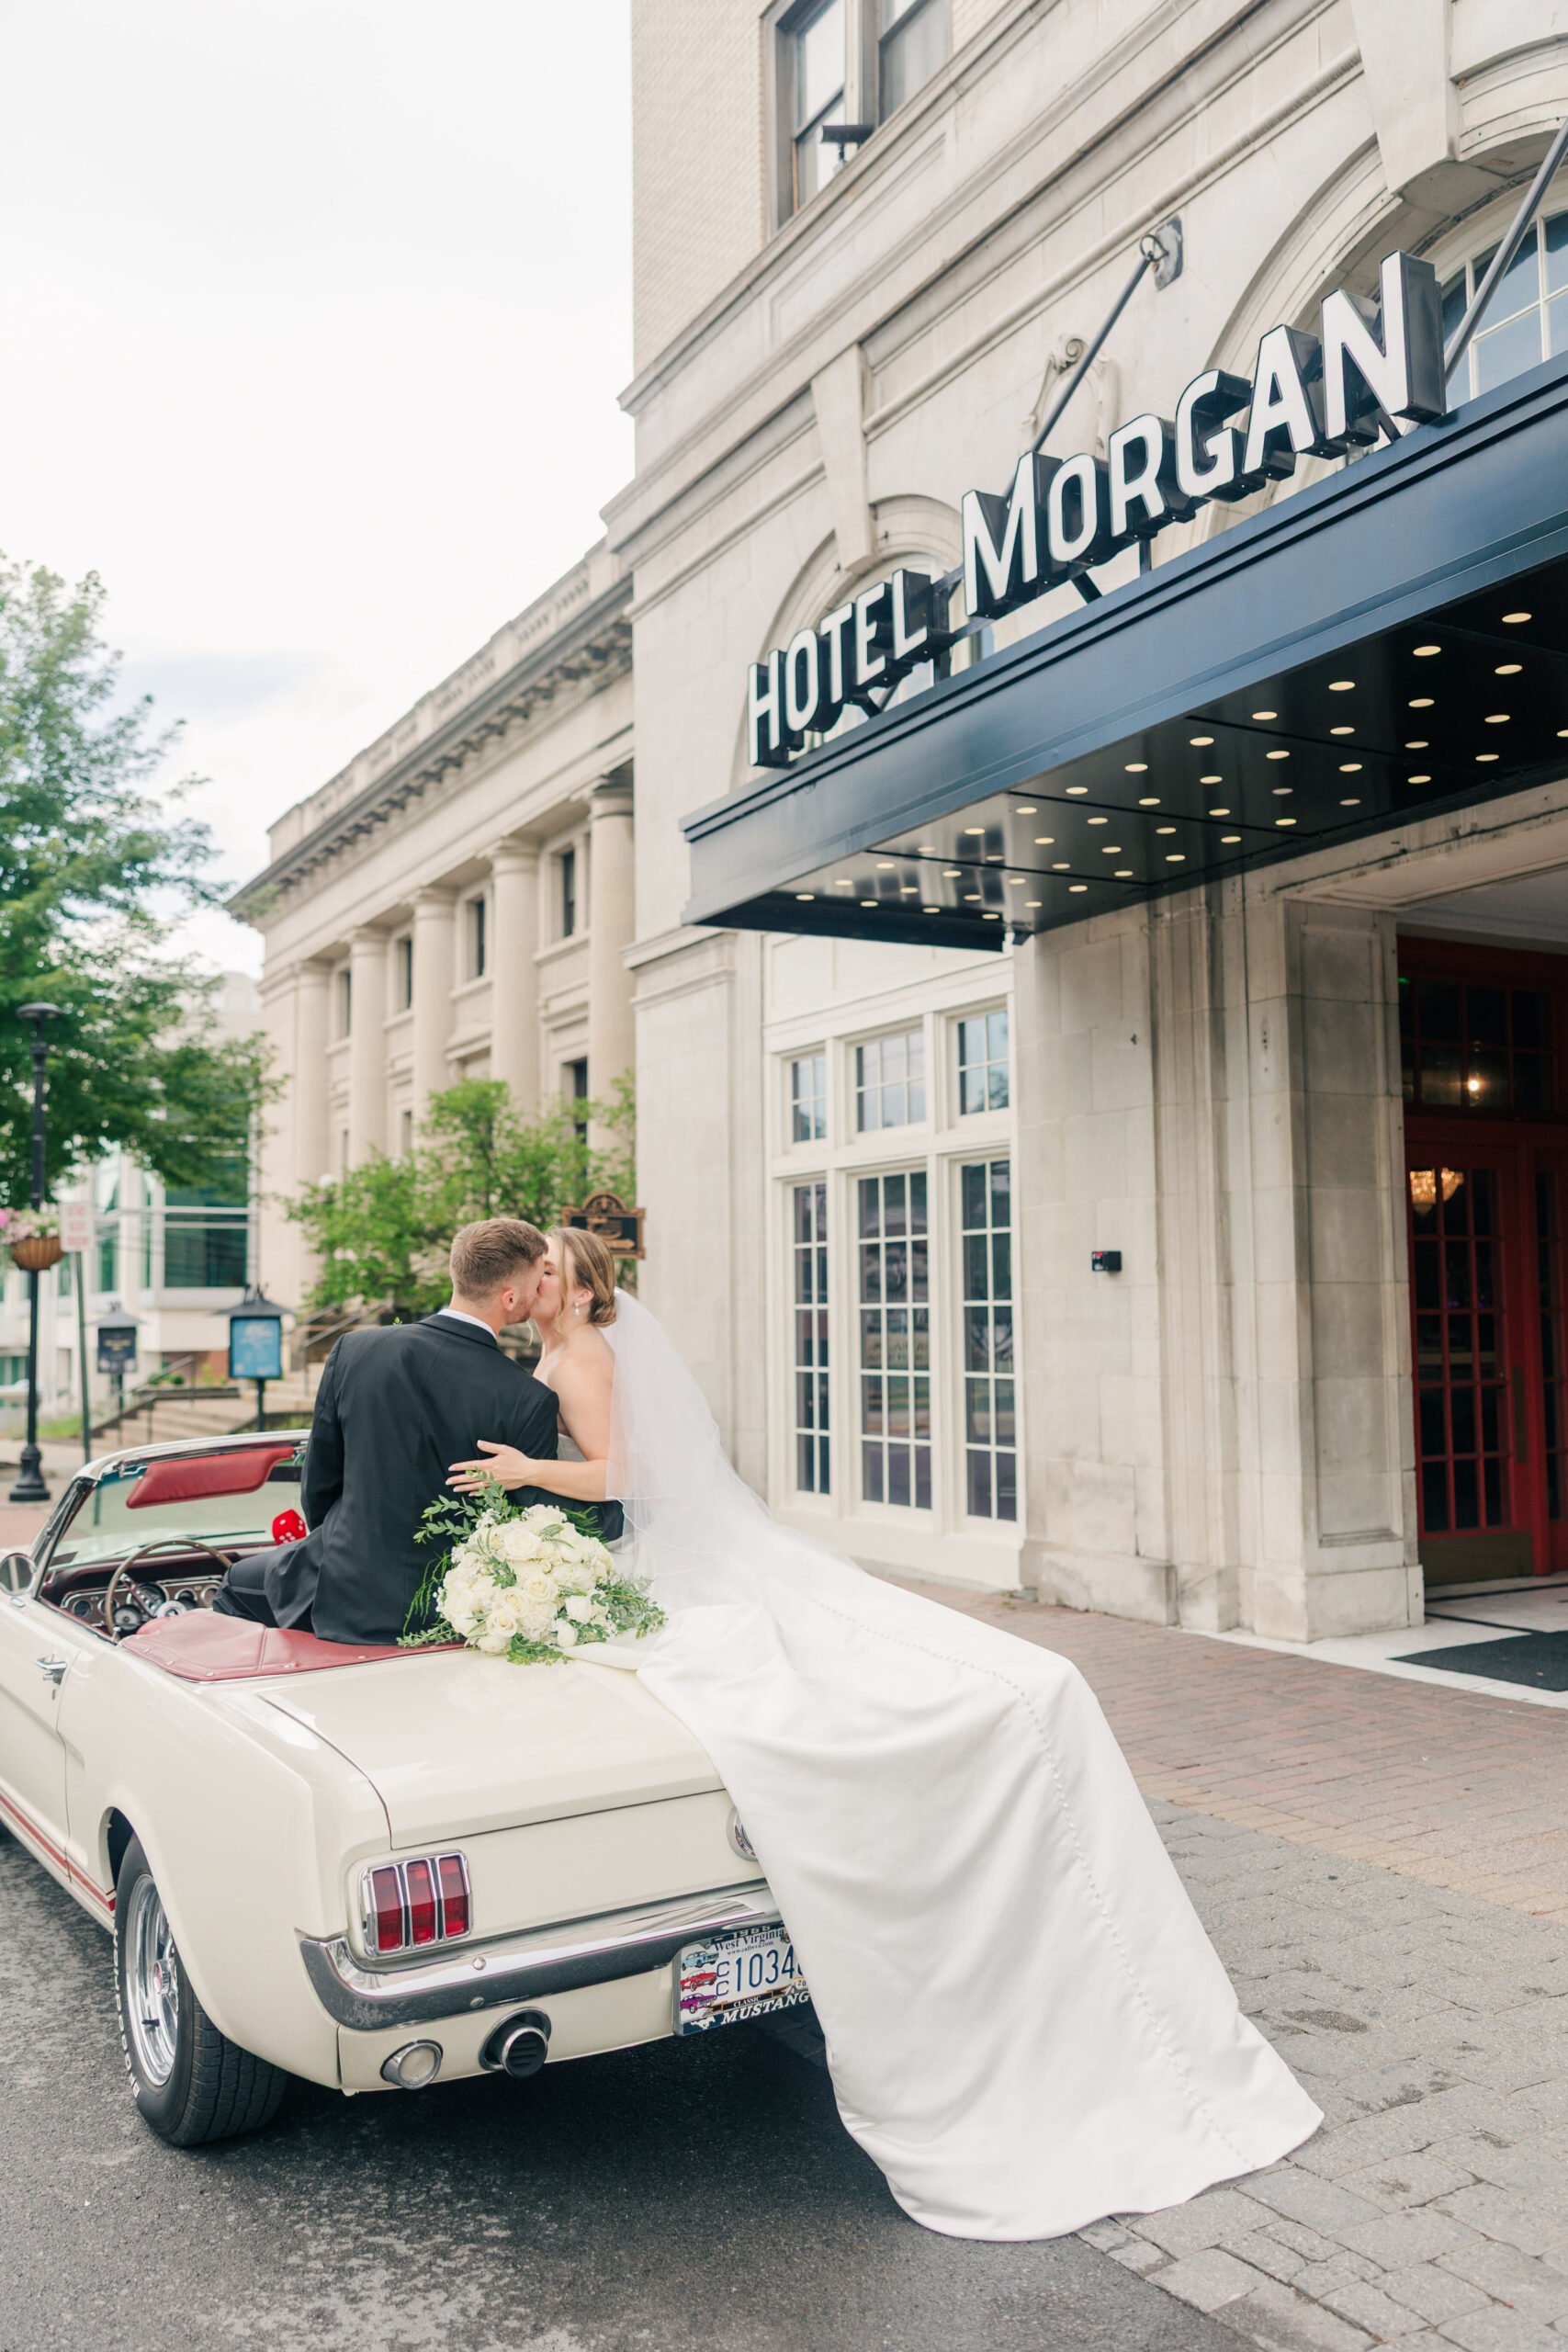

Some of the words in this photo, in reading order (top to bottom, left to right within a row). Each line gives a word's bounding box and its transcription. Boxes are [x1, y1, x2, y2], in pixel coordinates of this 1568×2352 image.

[748, 569, 928, 765] HOTEL
[963, 250, 1411, 617] MORGAN
[715, 1938, 739, 1951] West
[742, 1928, 784, 1944] Virginia
[720, 1990, 810, 2025] MUSTANG
[733, 1996, 761, 2007] CLASSIC
